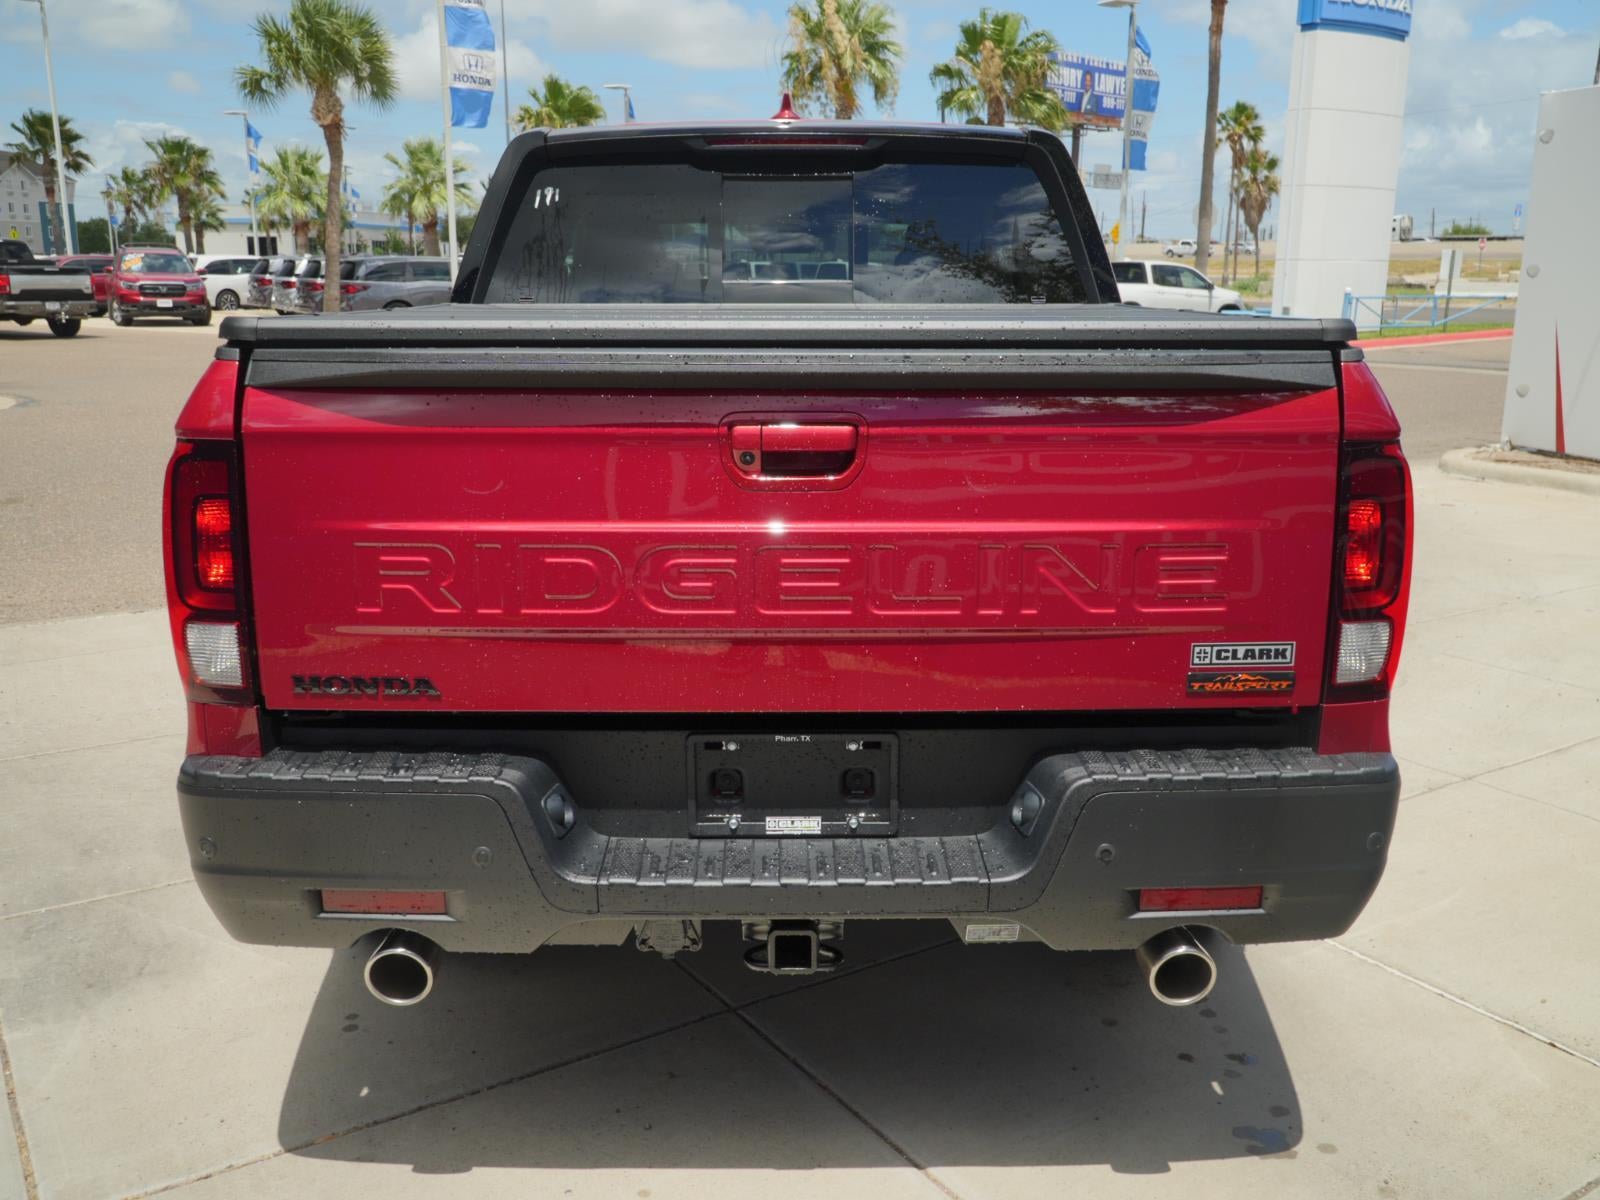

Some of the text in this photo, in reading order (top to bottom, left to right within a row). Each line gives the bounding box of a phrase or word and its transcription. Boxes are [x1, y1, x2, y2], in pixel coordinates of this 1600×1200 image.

[453, 73, 491, 86] HONDA
[1094, 72, 1126, 96] LAWYE
[353, 542, 1229, 614] RIDGELINE
[1215, 647, 1289, 661] CLARK
[292, 674, 441, 696] HONDA
[1190, 681, 1294, 692] TRAILSPORT
